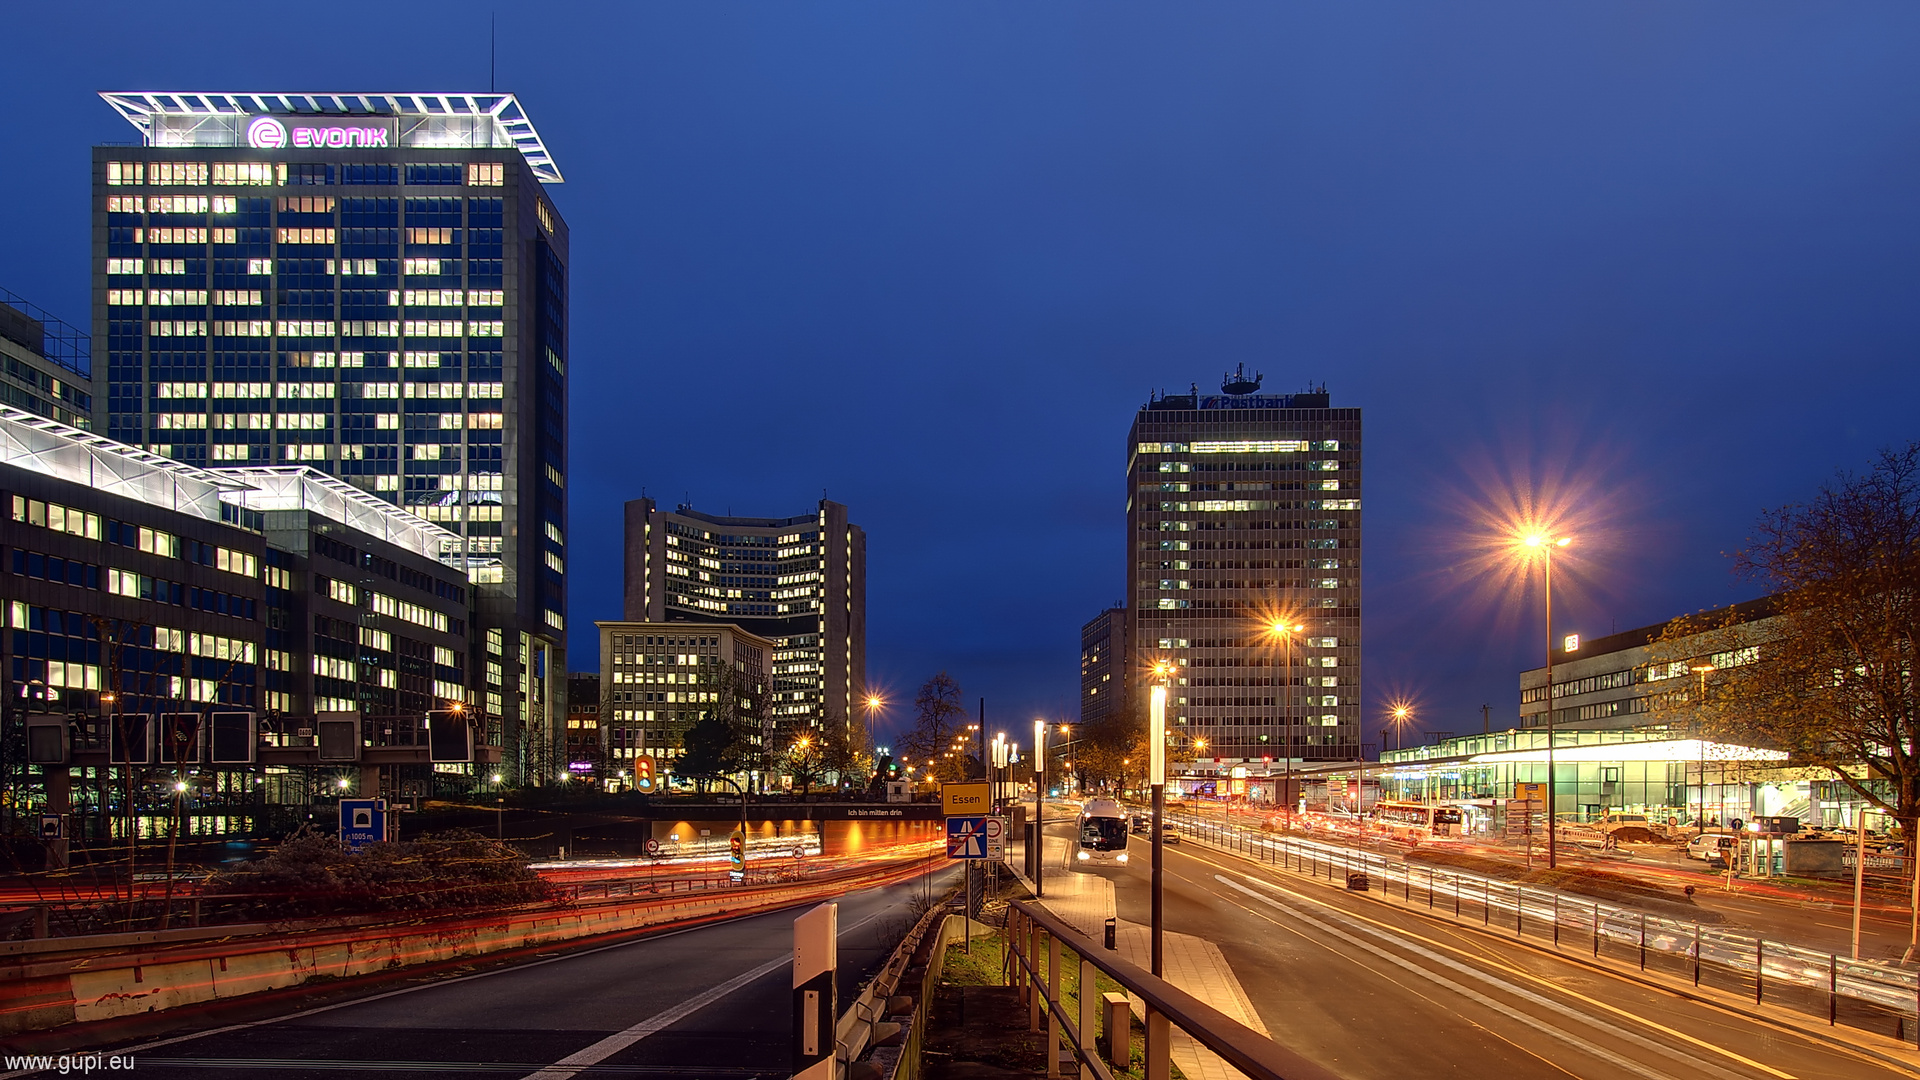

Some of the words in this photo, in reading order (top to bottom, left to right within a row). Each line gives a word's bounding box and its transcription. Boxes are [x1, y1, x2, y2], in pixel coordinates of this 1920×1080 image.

[292, 127, 388, 148] EVONIK
[1221, 395, 1294, 409] Postbank
[952, 795, 981, 804] Essen
